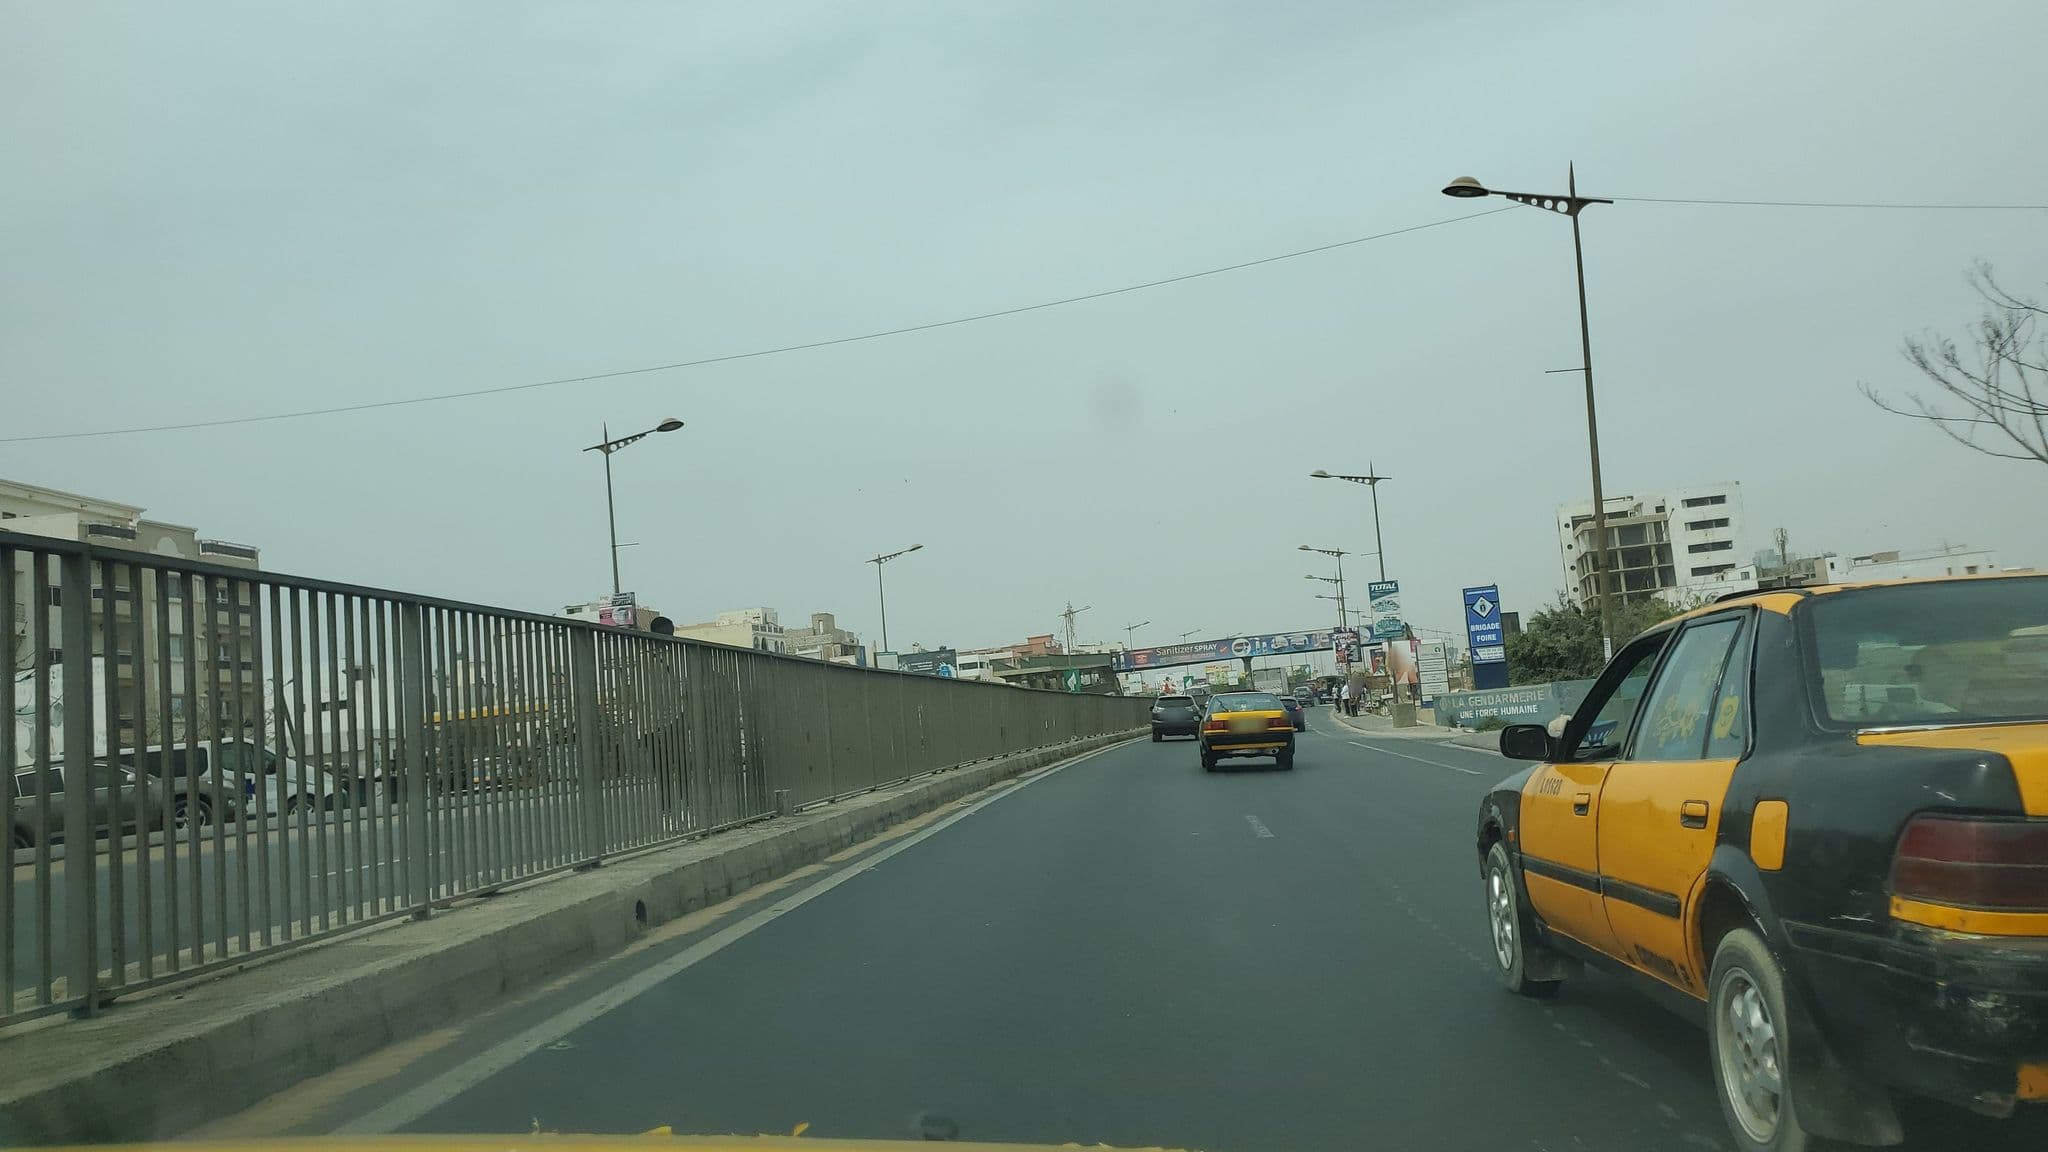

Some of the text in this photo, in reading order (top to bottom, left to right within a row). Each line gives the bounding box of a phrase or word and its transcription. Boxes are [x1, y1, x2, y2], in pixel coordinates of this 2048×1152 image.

[1370, 583, 1397, 591] TOTAL
[1471, 622, 1501, 632] BRIGADE
[1476, 634, 1497, 642] FOIRE
[1156, 643, 1217, 656] Sanitizer SPRAY
[1452, 690, 1545, 708] LA GENDARMERIE
[1460, 704, 1539, 719] UNE FORCE HUMAINE
